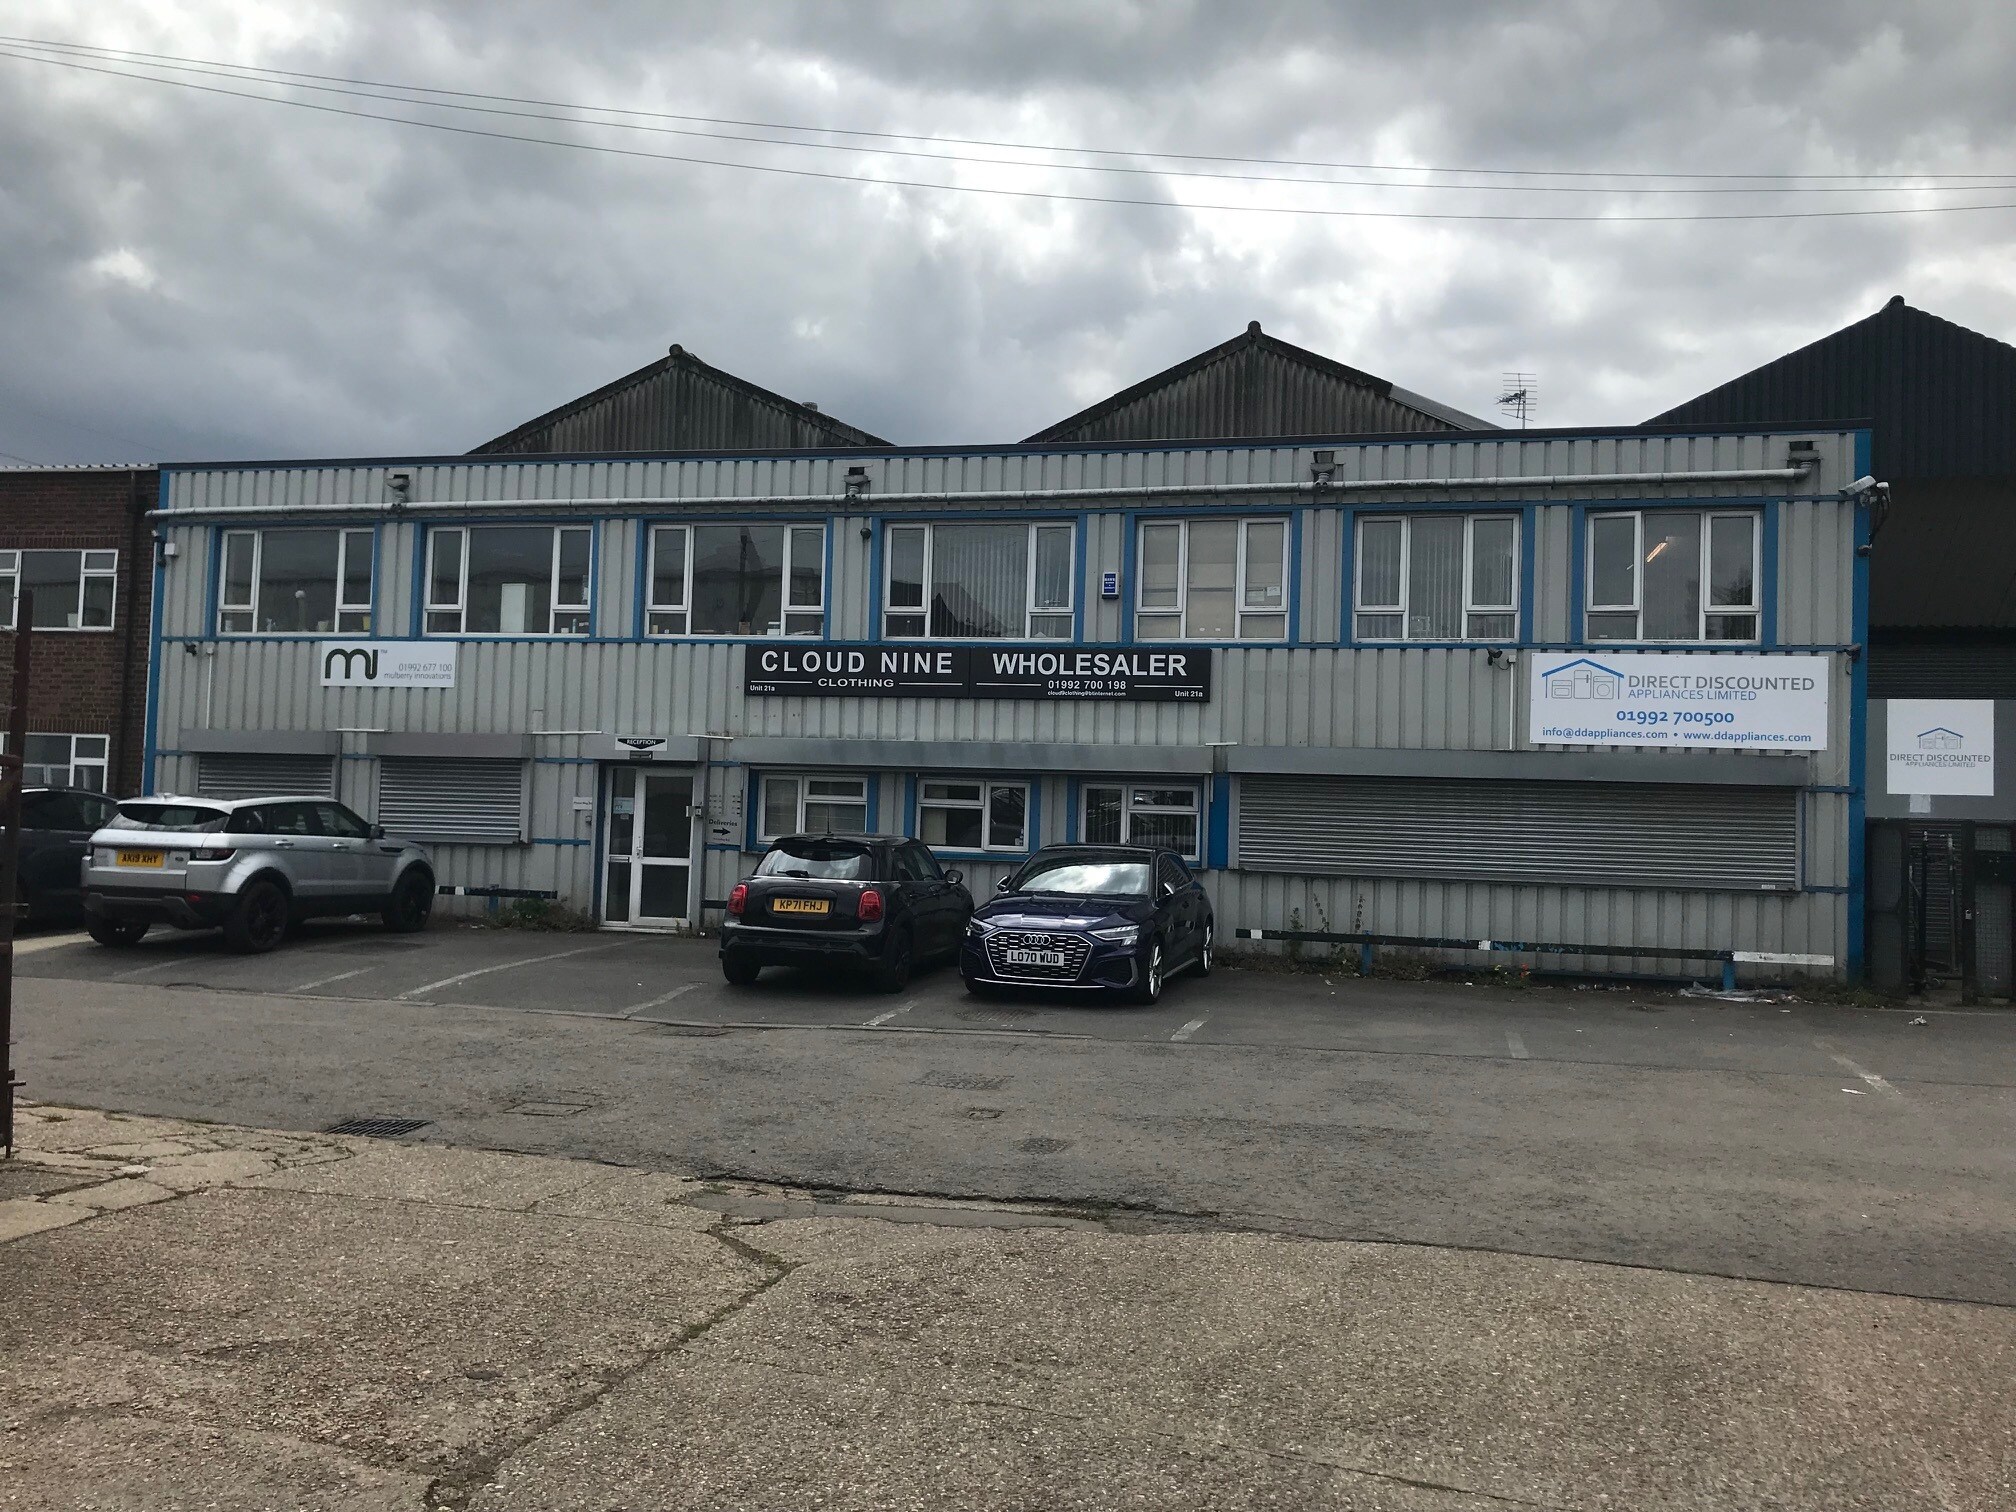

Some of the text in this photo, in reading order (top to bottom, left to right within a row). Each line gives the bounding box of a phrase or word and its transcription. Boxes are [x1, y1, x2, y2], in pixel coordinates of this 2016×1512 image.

[398, 663, 453, 672] 01992 677 100
[761, 650, 953, 674] CLOUD NINE
[992, 653, 1188, 677] WHOLESALER
[384, 671, 451, 680] mulberry innovations
[750, 684, 763, 692] Unit
[817, 678, 894, 688] CLOTHING
[1048, 680, 1127, 690] 01992 700 198
[1628, 675, 1815, 691] DIRECT DISCOUNTED
[1628, 689, 1757, 701] APPLIANCES LIMITED
[1616, 710, 1734, 726] 01992 700500
[1542, 726, 1812, 743] info@ddappliances.com www.ddappliances.com
[1889, 753, 1991, 762] DIRECT DISCOUNTED
[709, 818, 738, 827] Deliveries
[780, 900, 823, 911] KP71 FHJ
[1010, 951, 1059, 964] LO70 WUD
